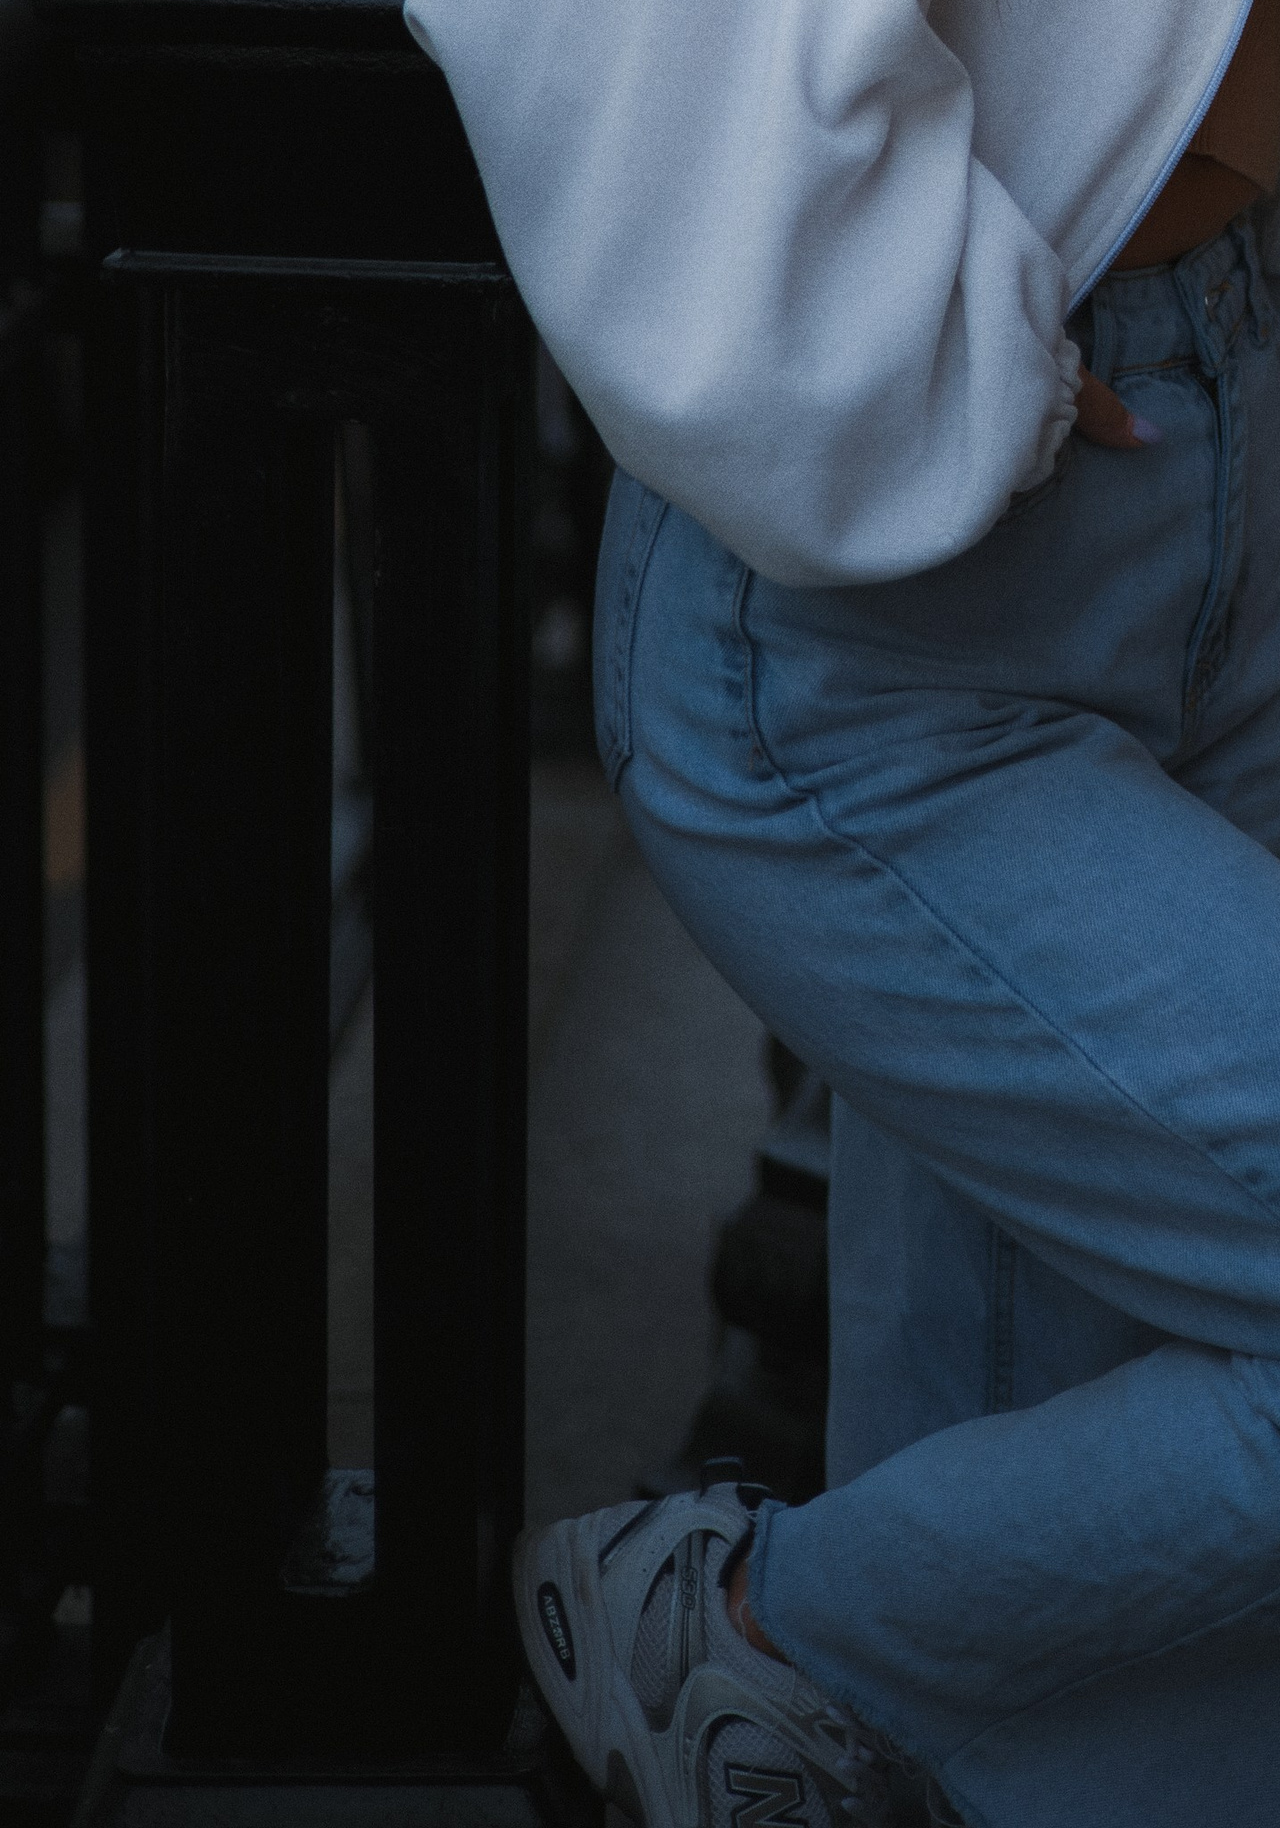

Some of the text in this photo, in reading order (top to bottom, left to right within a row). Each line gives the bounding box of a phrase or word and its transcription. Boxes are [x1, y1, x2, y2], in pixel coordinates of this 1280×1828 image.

[680, 1566, 699, 1610] 530
[544, 1596, 570, 1660] ABZORB
[724, 1763, 808, 1828] N
